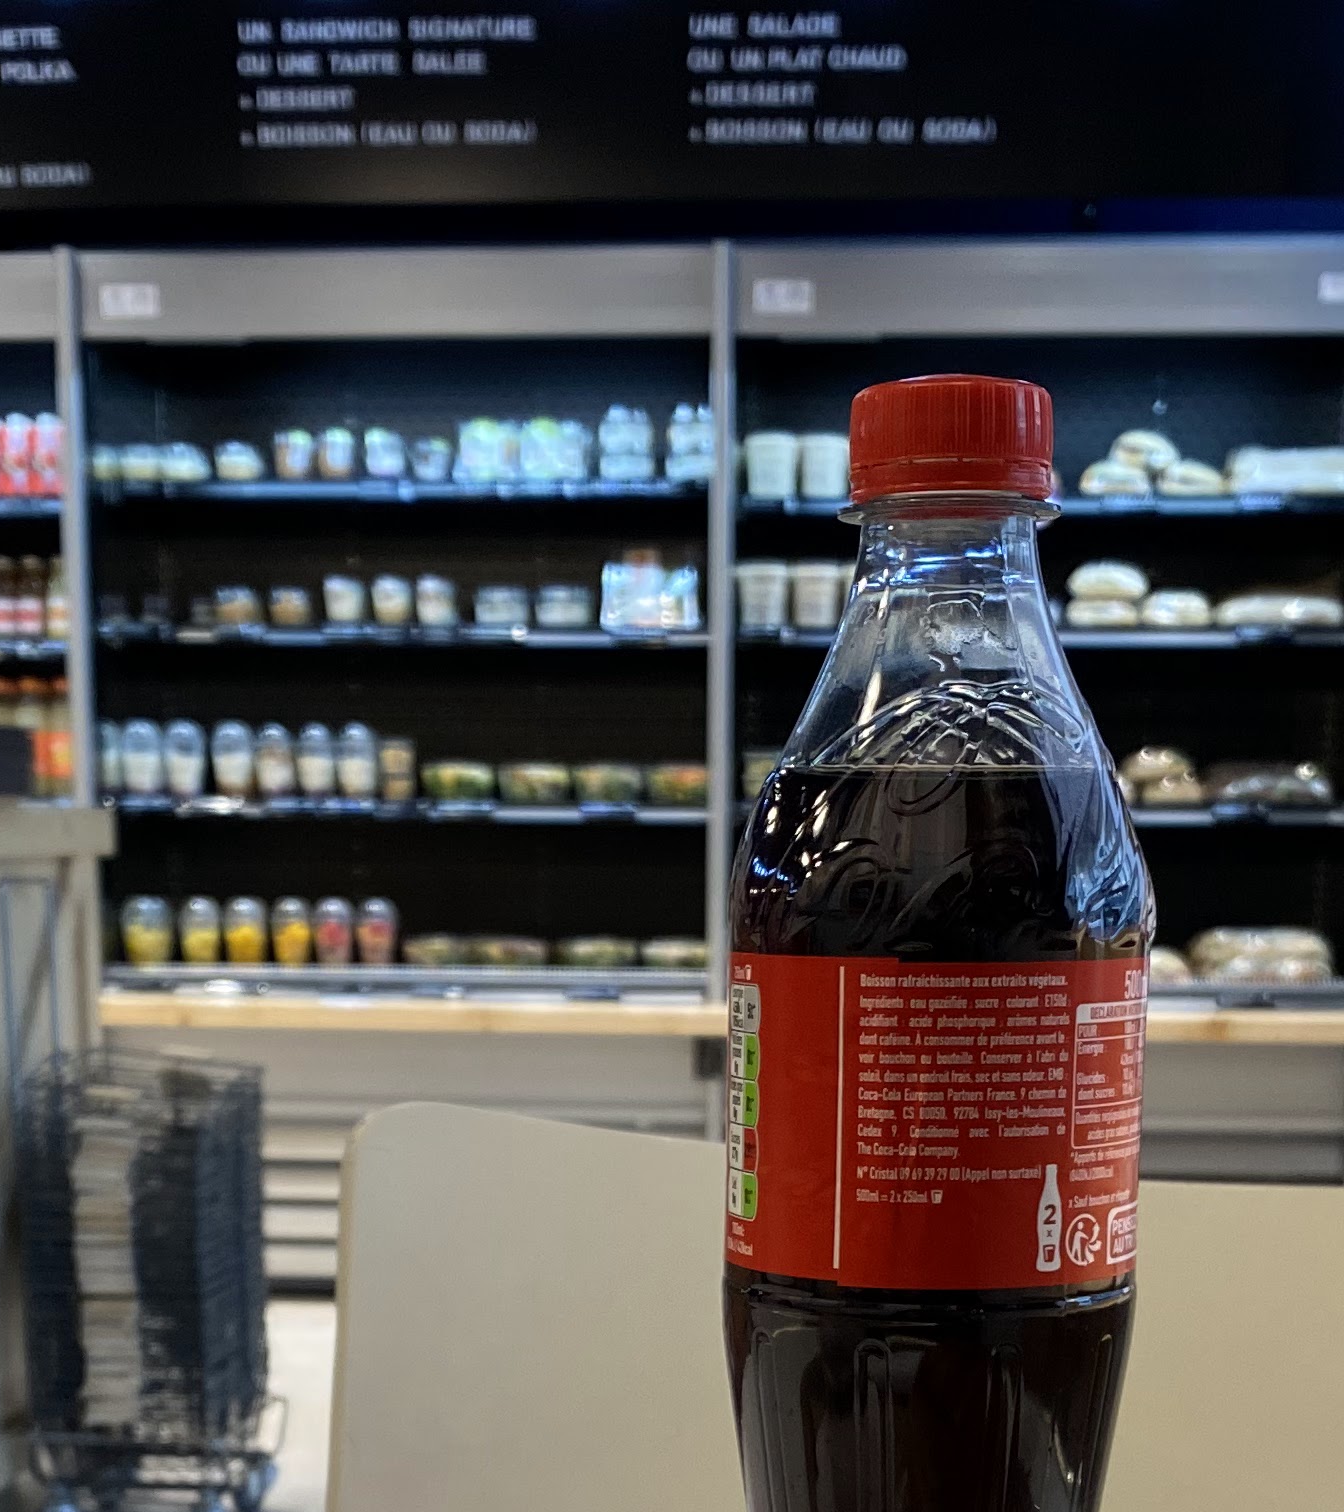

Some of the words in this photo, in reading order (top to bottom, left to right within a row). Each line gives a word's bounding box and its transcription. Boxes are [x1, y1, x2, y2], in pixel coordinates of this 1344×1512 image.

[281, 17, 400, 43] SANDWICH
[860, 973, 896, 987] Boisson
[972, 977, 989, 987] aux
[991, 973, 1026, 987] extraits
[1029, 972, 1068, 988] végétaux.
[858, 1087, 901, 1100] Coca-Cola
[904, 1088, 944, 1104] European
[947, 1088, 983, 1101] Partners
[857, 1142, 871, 1154] The
[873, 1142, 916, 1156] Coca-Cola
[870, 1166, 897, 1180] Cristal
[899, 1167, 910, 1180] 09
[1043, 1204, 1056, 1224] 2
